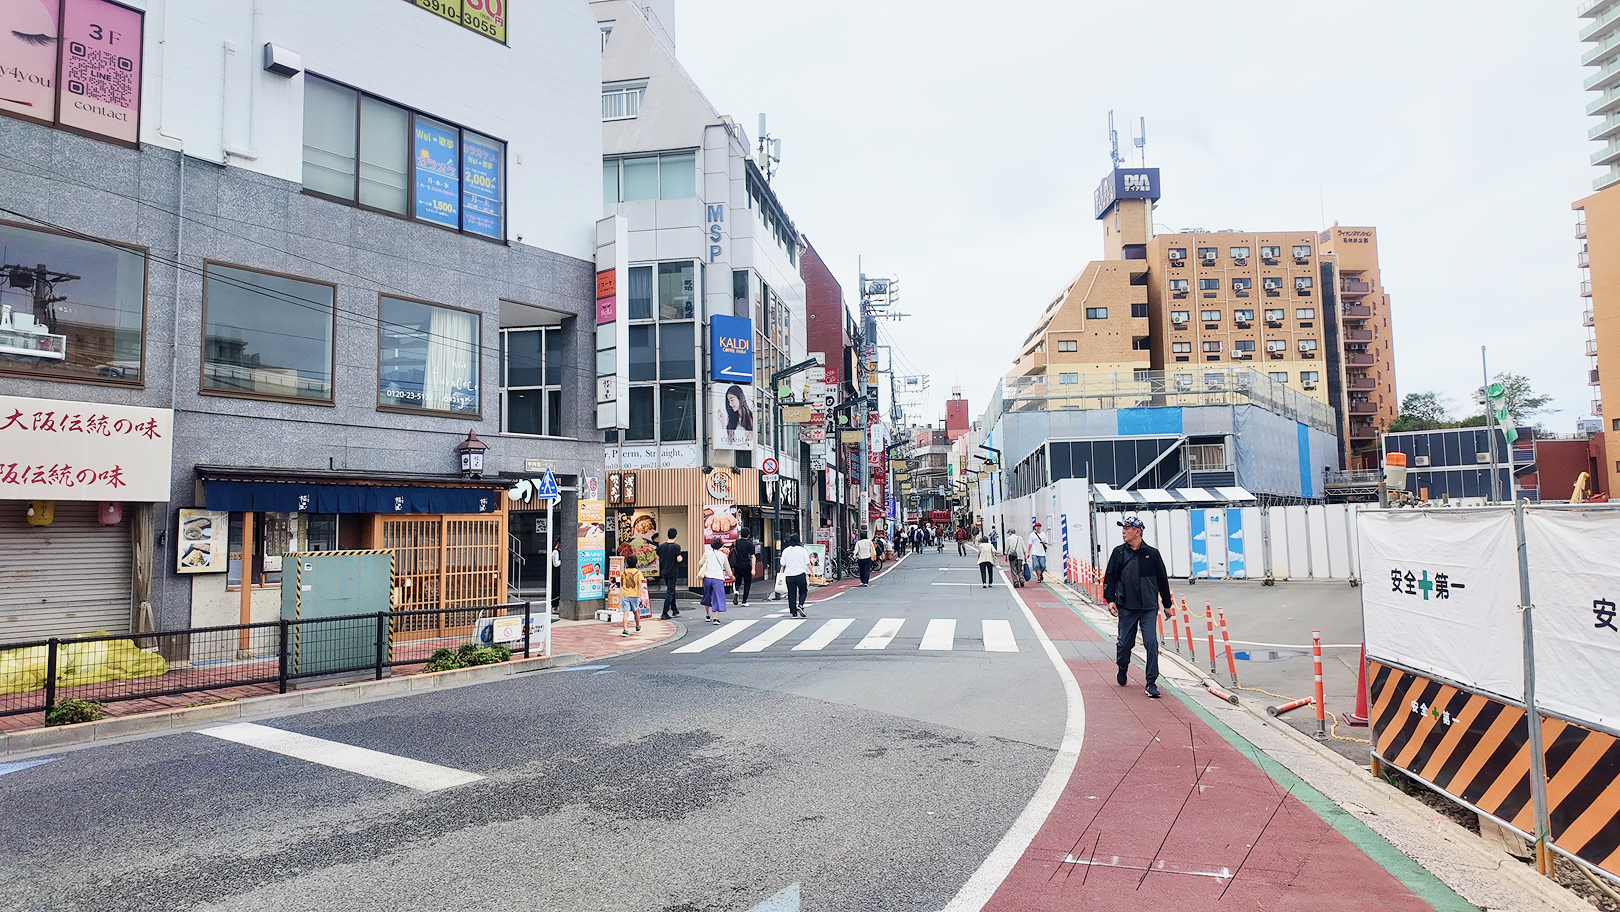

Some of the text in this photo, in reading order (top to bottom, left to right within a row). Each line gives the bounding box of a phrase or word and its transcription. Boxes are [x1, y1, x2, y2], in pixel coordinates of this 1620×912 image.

[91, 70, 111, 82] LINE
[74, 100, 128, 122] contact
[1124, 174, 1150, 187] DIA
[707, 204, 724, 263] MSP
[719, 336, 749, 350] KALDI
[0, 408, 162, 440] 大阪伝統の味
[609, 474, 620, 503] からあげ
[624, 475, 635, 500] 浅草
[1391, 568, 1466, 599] 安全 第一
[1593, 598, 1618, 632] 安
[1411, 699, 1428, 718] 安全
